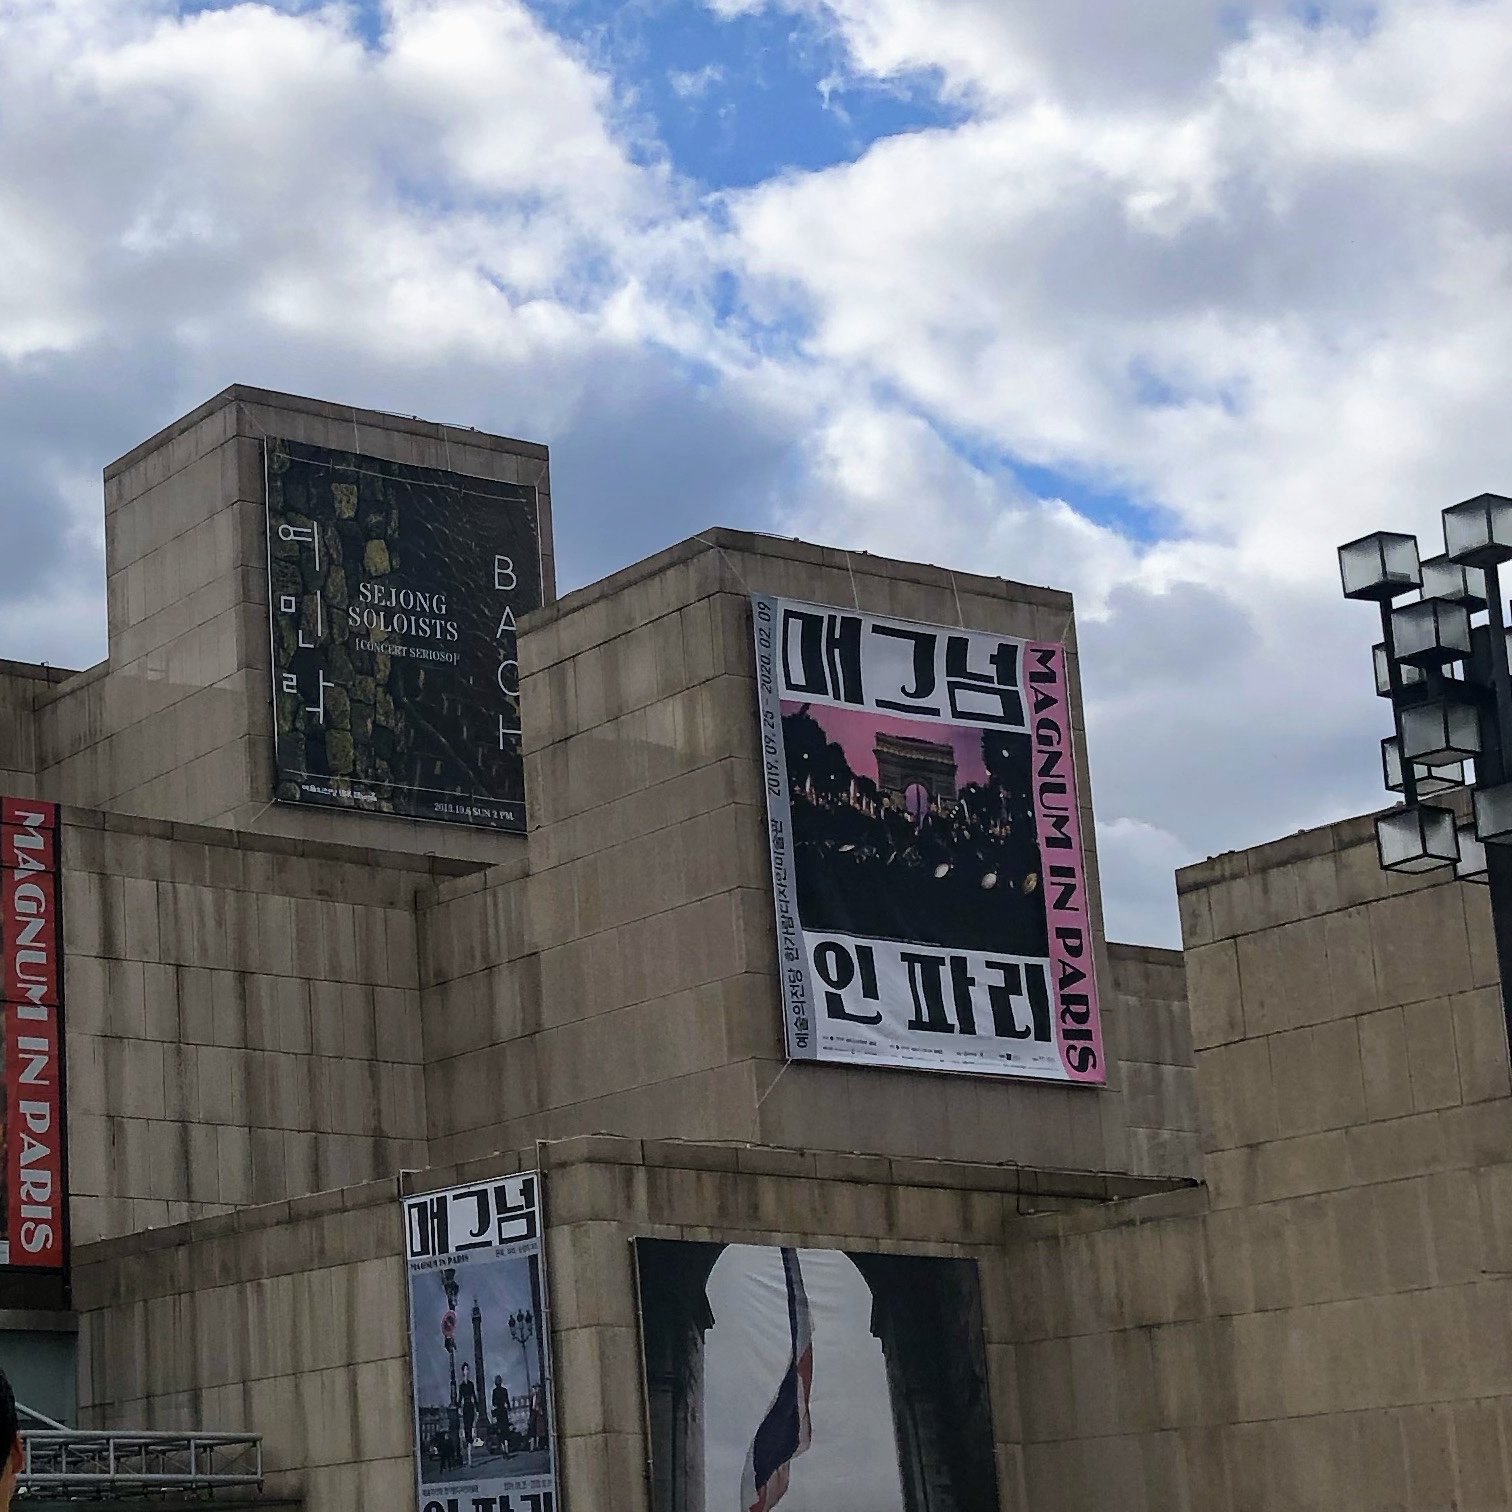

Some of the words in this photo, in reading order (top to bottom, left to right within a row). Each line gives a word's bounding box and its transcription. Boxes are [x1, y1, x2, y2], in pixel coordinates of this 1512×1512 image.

[348, 606, 458, 641] SOLOISTS
[359, 582, 447, 615] SEJONG
[757, 601, 771, 623] 09
[782, 608, 1026, 727] 매그넘
[1028, 648, 1073, 850] MAGNUM
[13, 810, 48, 1021] MAGNUM
[771, 818, 800, 962] 한가람디자인미술관
[1049, 865, 1079, 912] IN
[788, 968, 809, 1049] 예술의전당
[813, 941, 883, 1025] 인
[900, 951, 1052, 1042] 파리
[1055, 926, 1097, 1073] PARIS
[17, 1036, 50, 1085] IN
[19, 1100, 53, 1253] PARIS
[407, 1177, 537, 1257] 매그넘
